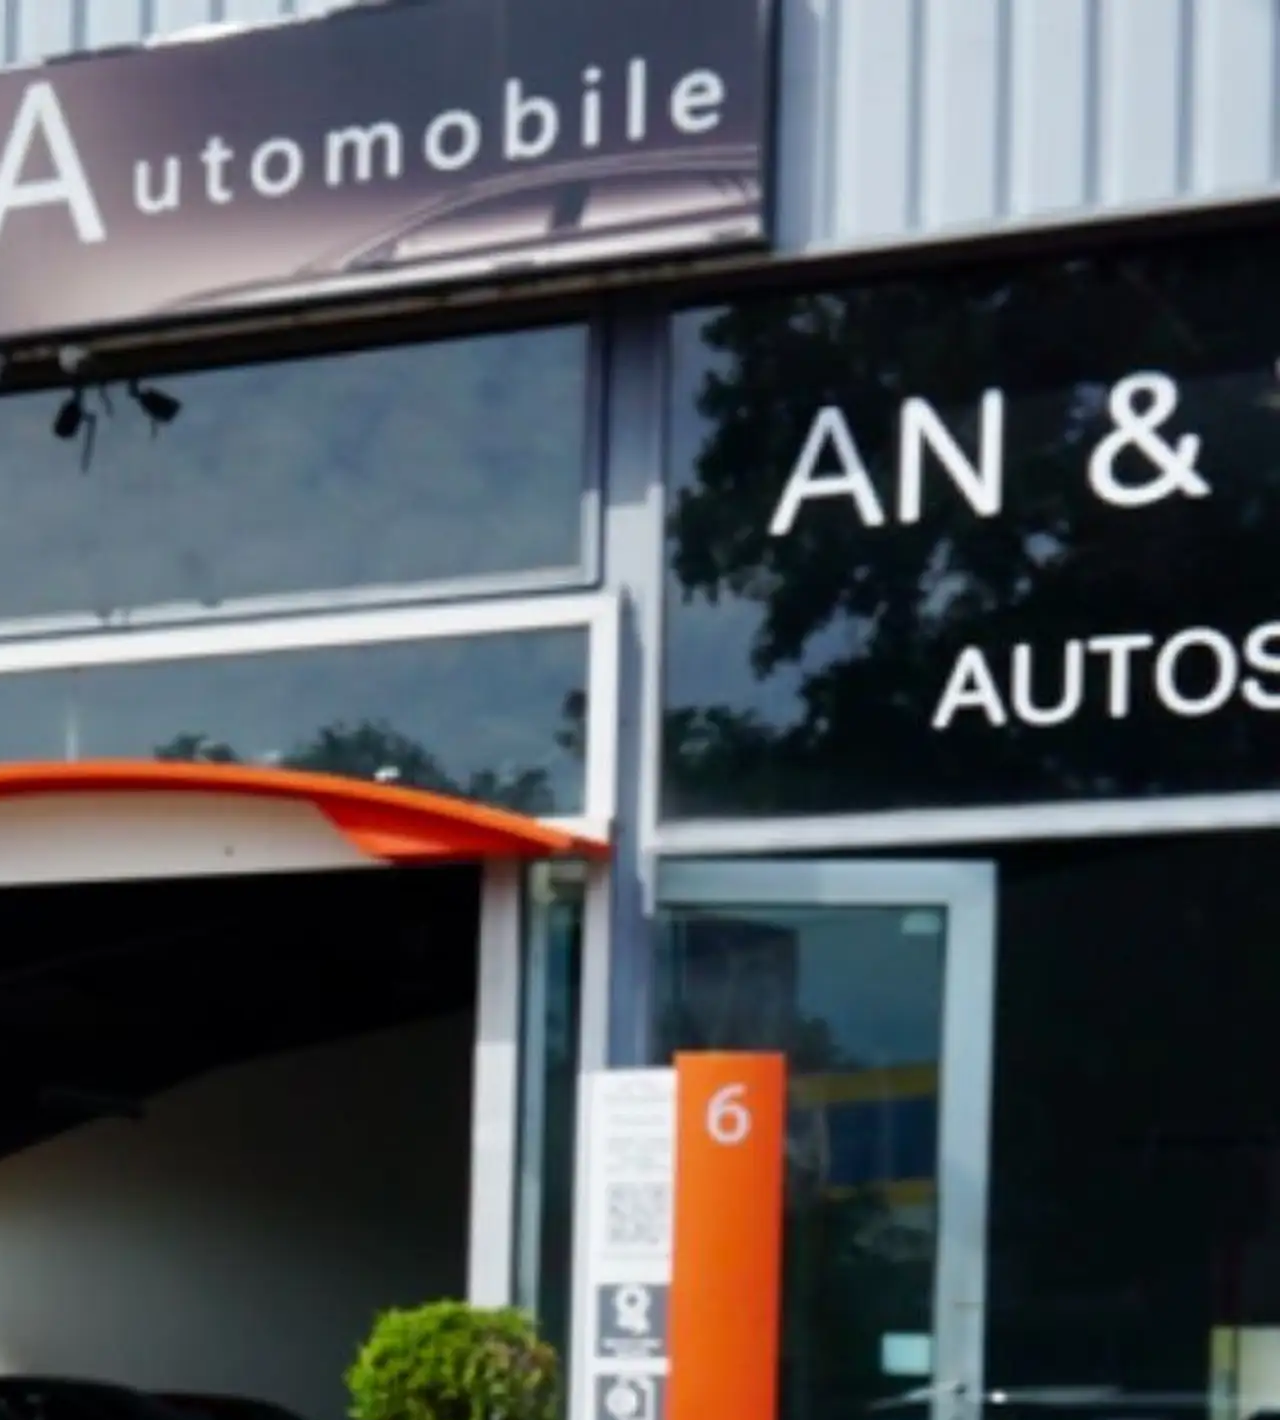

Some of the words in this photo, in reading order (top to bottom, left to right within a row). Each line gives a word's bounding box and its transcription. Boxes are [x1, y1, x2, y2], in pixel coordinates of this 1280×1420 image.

[768, 387, 1005, 537] AN
[1087, 370, 1211, 508] &
[701, 1080, 755, 1147] 6
